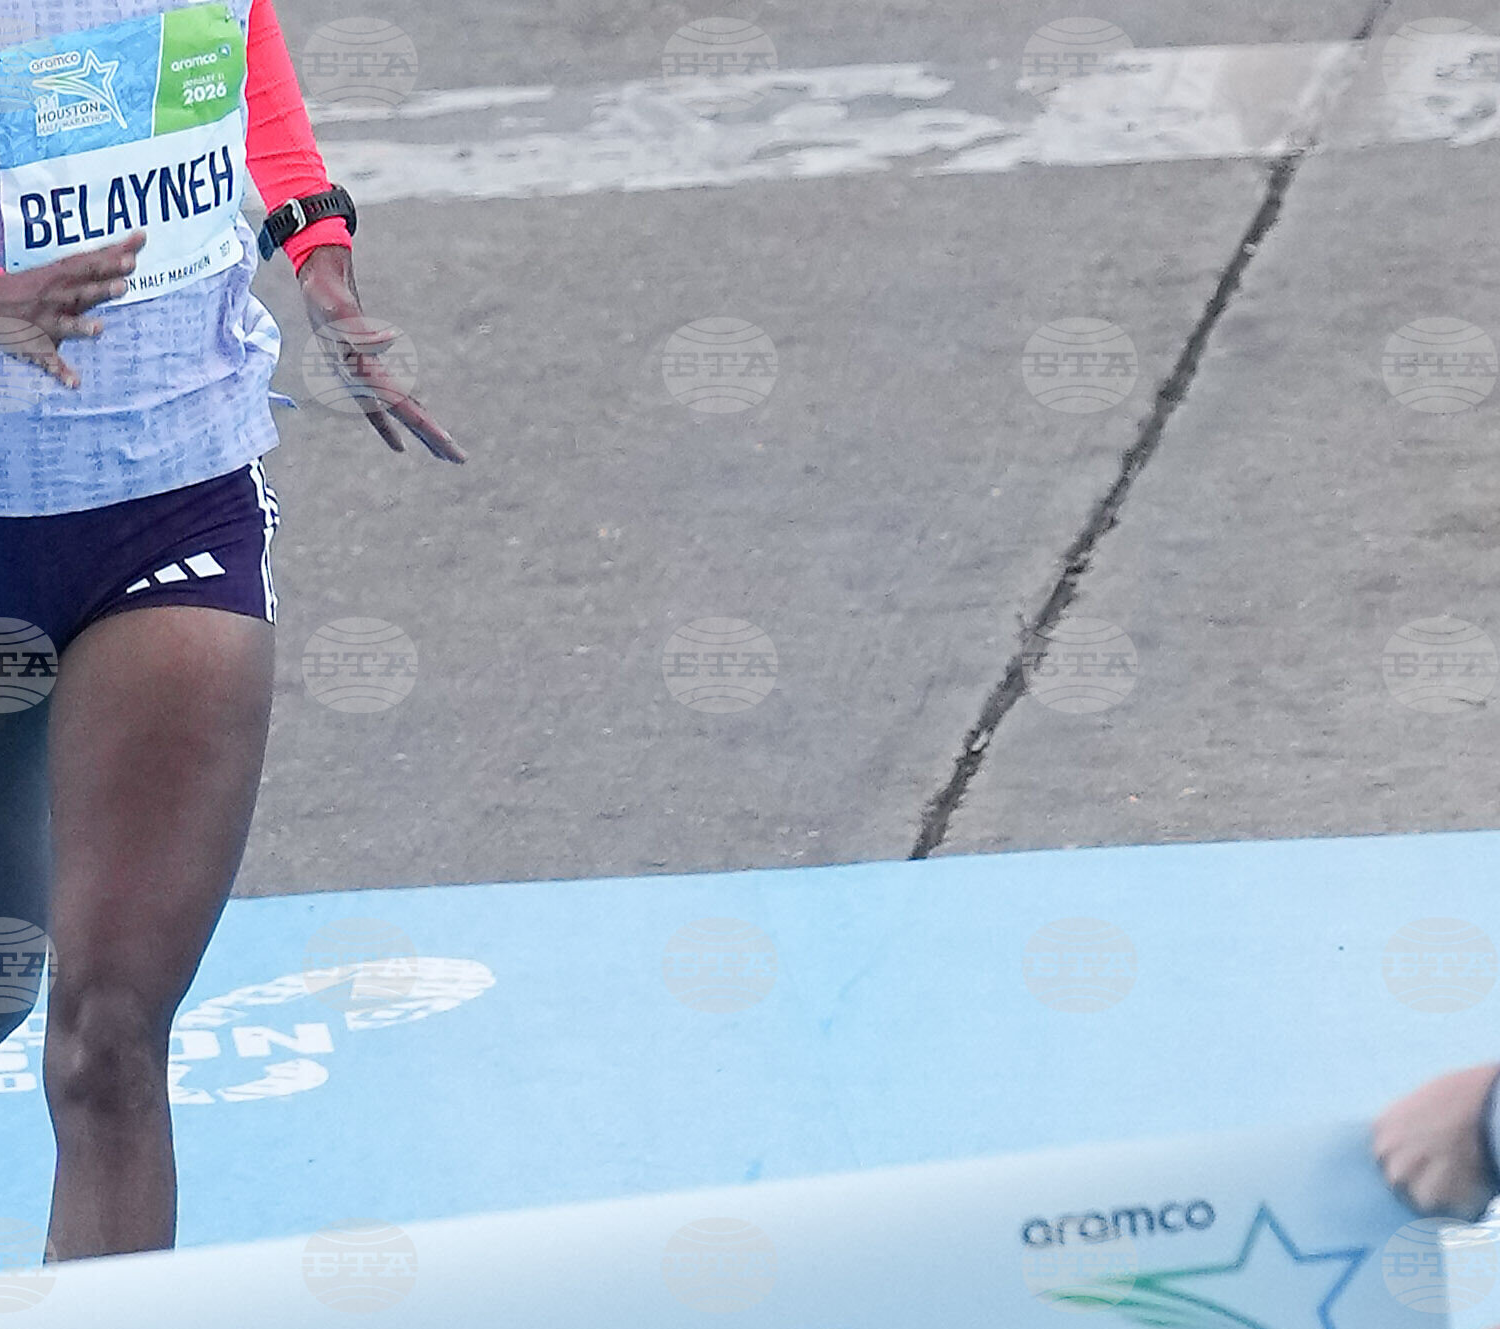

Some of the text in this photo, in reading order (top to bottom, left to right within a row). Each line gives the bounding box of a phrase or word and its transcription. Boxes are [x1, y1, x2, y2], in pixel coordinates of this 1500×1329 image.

[31, 53, 79, 71] aramco
[171, 53, 218, 72] aramco
[183, 82, 227, 106] 2026
[38, 101, 99, 124] HOUSTON
[19, 145, 234, 250] BELAYNEH
[140, 273, 164, 290] HALF
[1022, 1199, 1216, 1248] aramco
